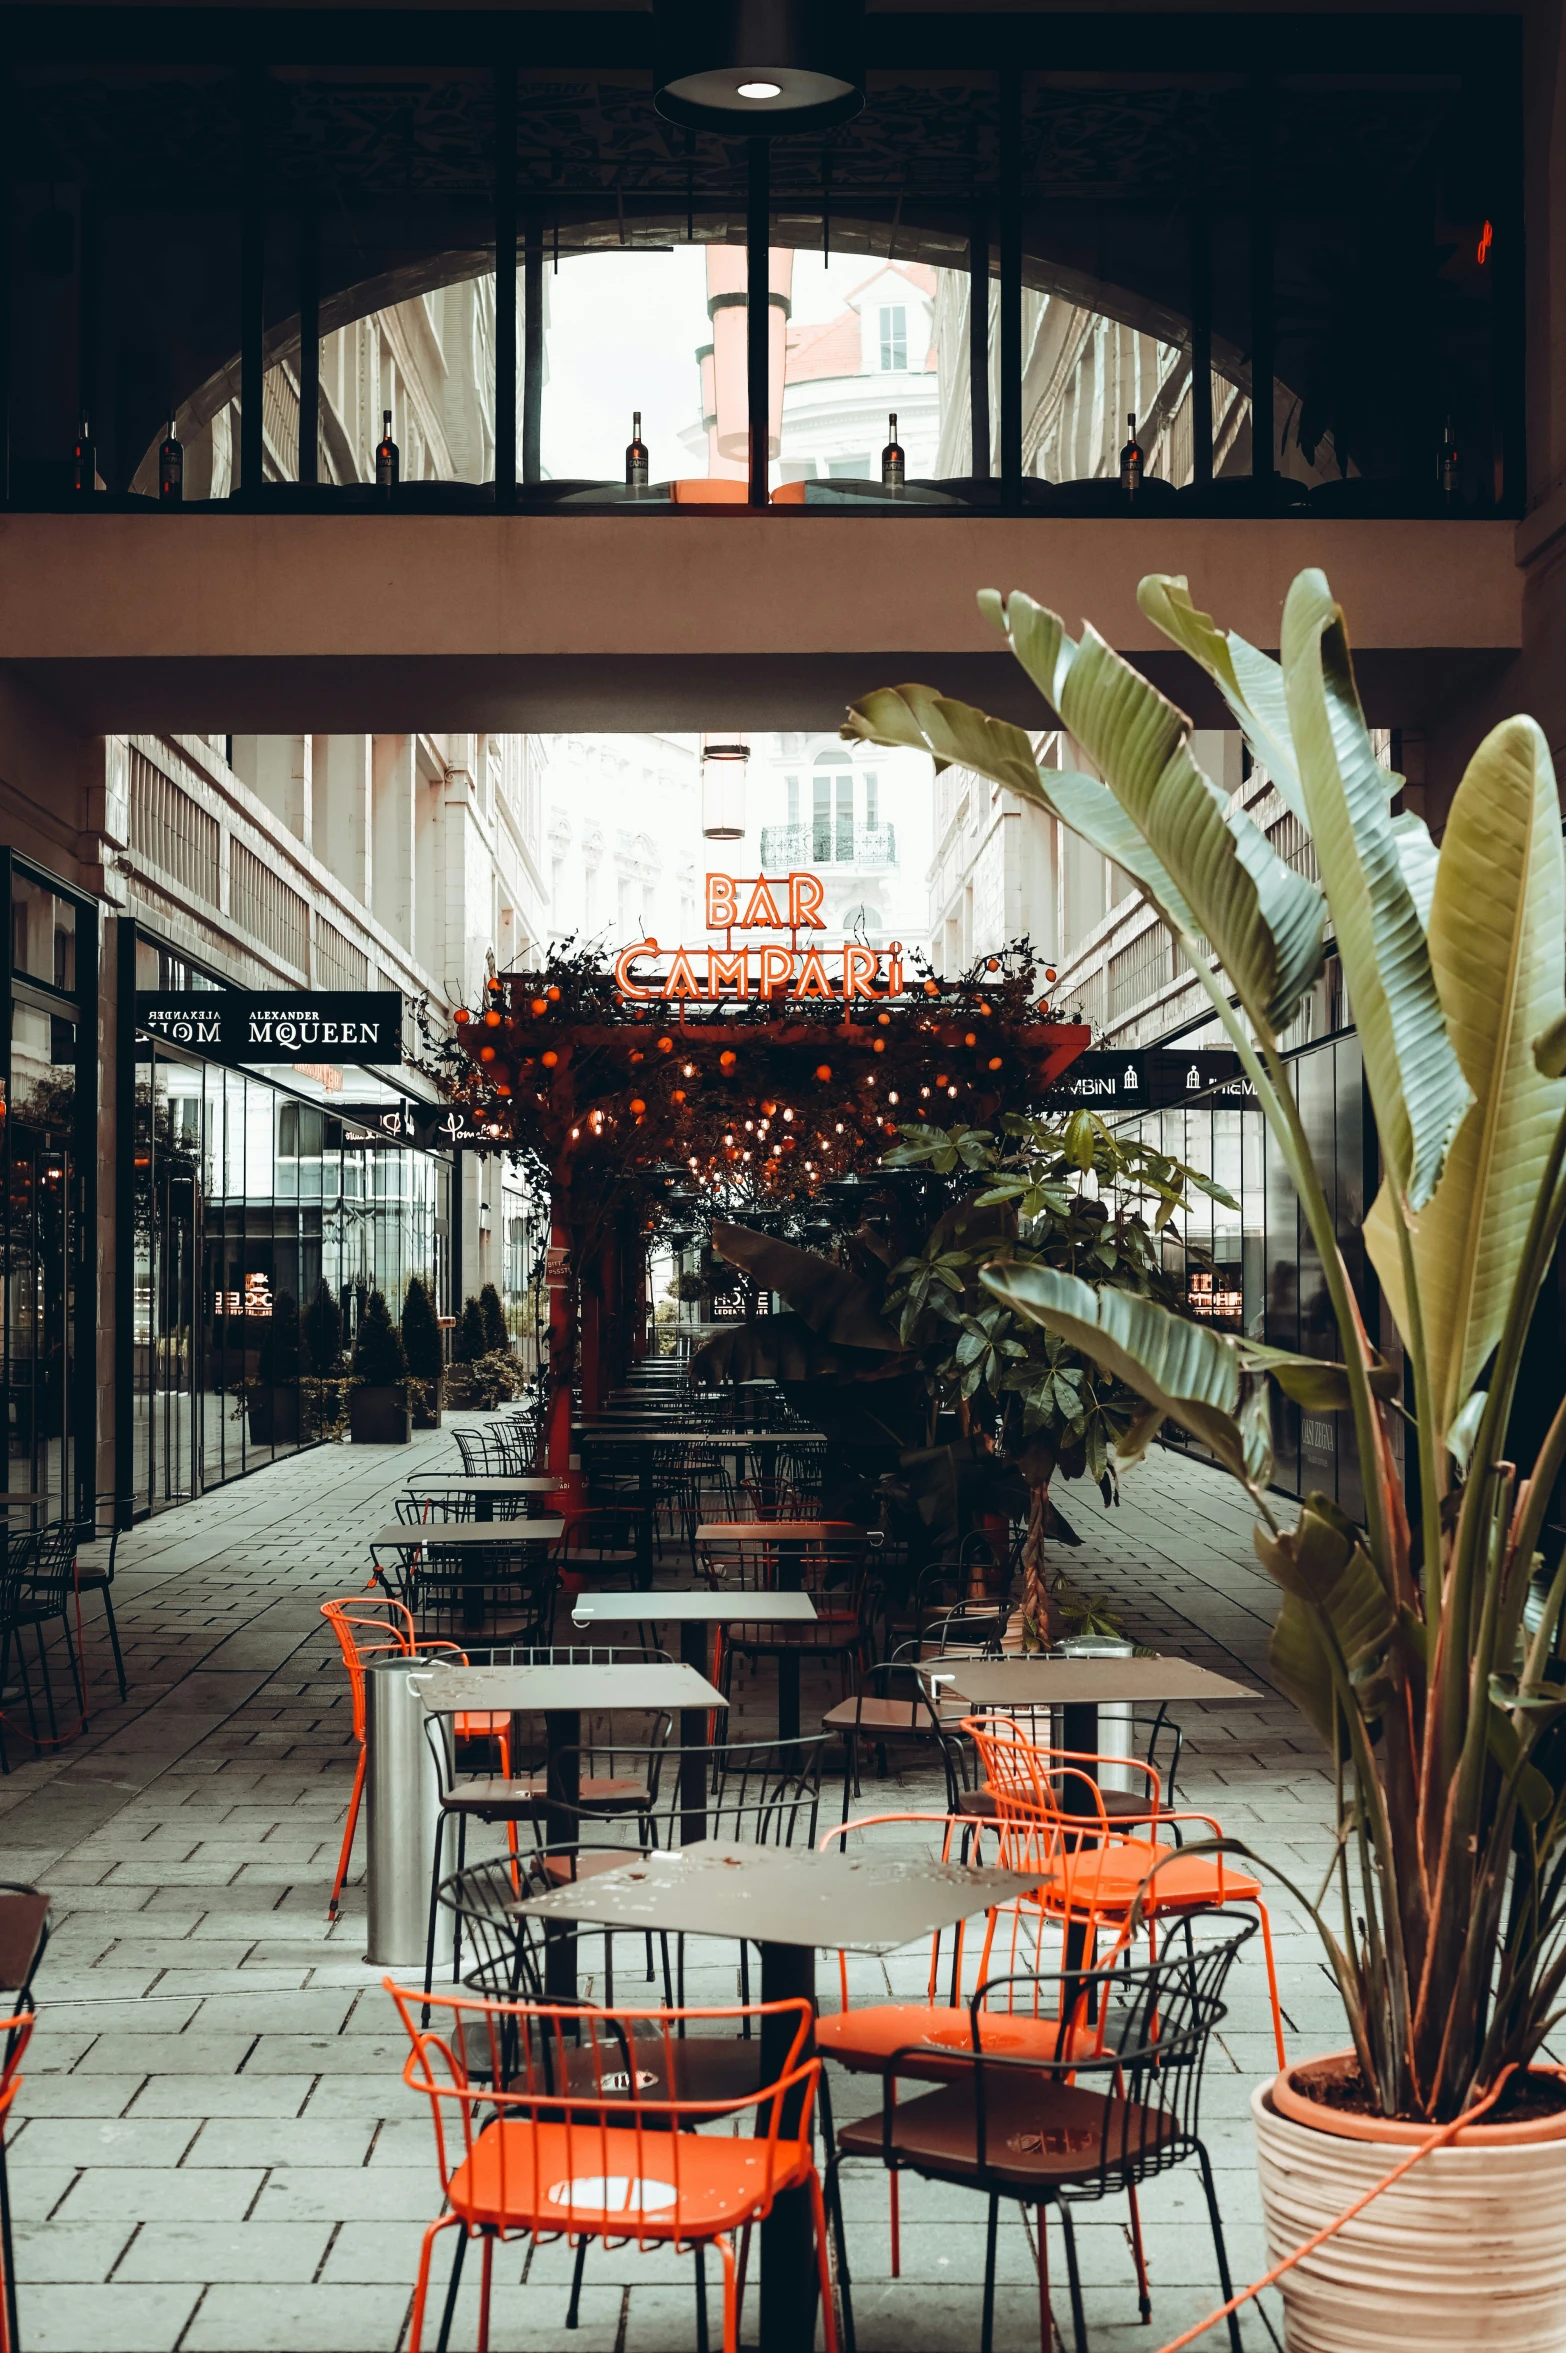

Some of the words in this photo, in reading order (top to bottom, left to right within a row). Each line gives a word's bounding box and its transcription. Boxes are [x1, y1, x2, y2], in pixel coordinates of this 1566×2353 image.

[705, 872, 827, 930] BAR
[249, 1011, 320, 1020] ALEXANDER
[547, 1260, 566, 1268] BITT
